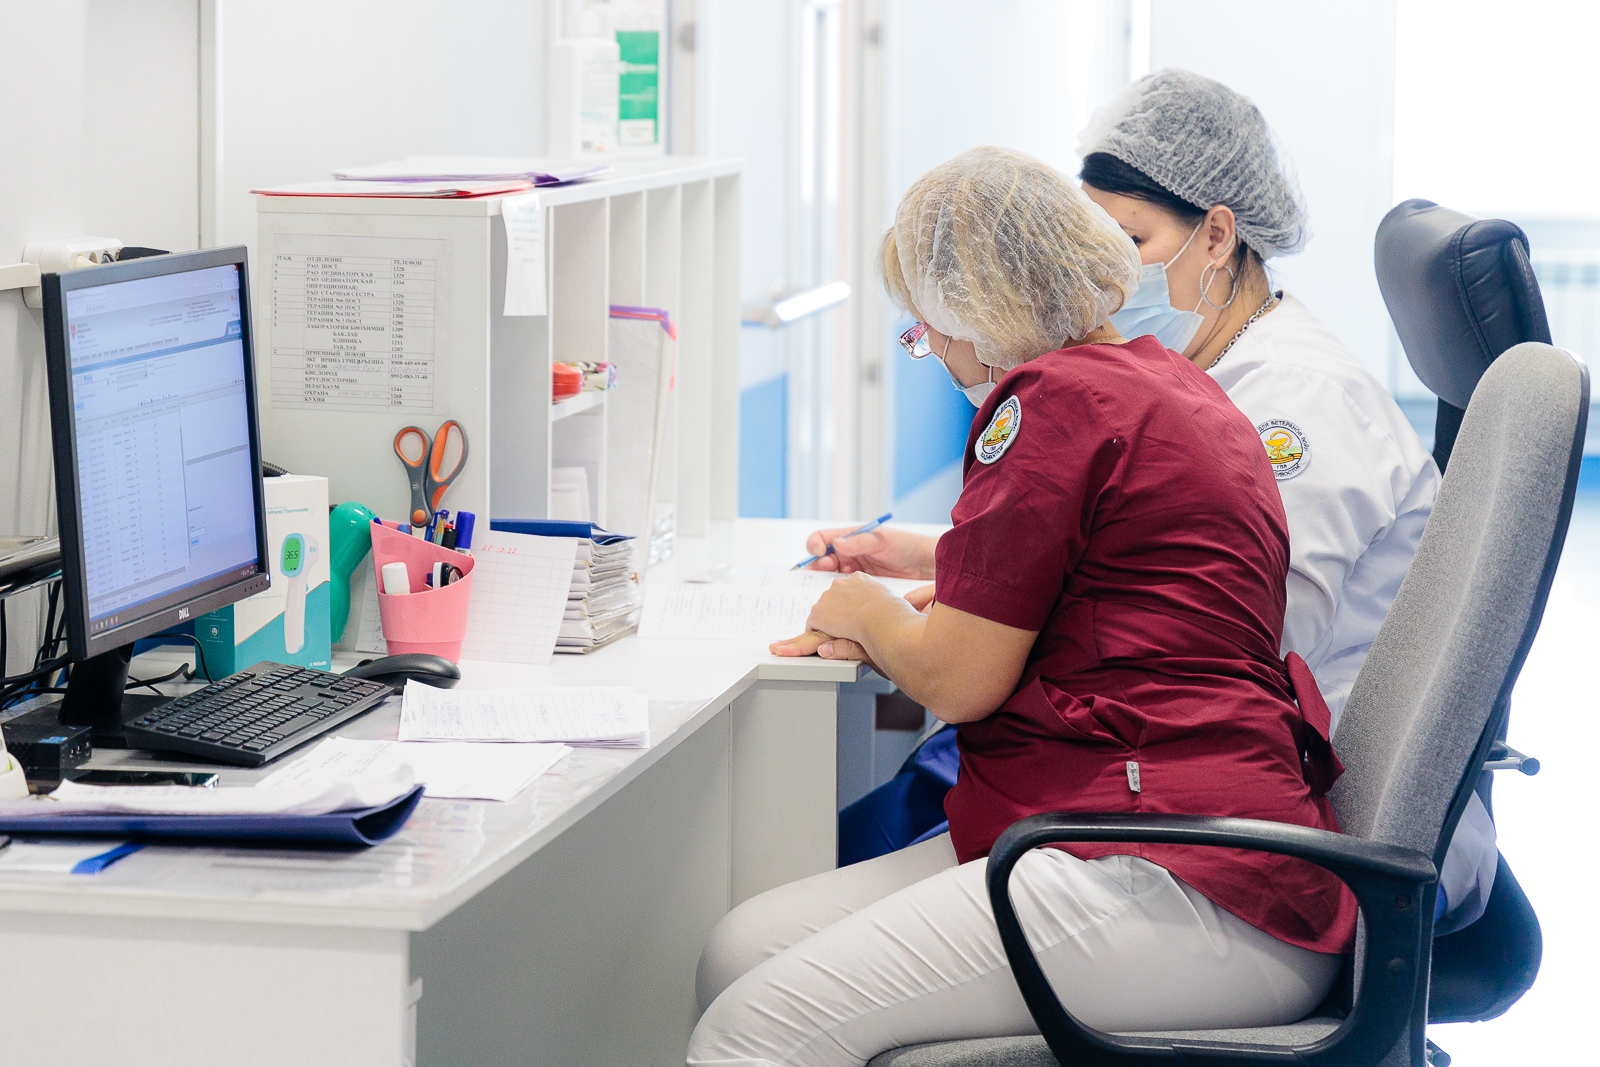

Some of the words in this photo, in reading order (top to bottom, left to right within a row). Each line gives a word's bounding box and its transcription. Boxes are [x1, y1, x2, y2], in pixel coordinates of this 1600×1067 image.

[1258, 422, 1269, 432] ДЛЯ
[1271, 420, 1302, 436] ВЕТЕРАНОВ
[1301, 436, 1310, 452] ВОЙН
[286, 550, 299, 560] 36.5
[178, 607, 190, 620] DELL
